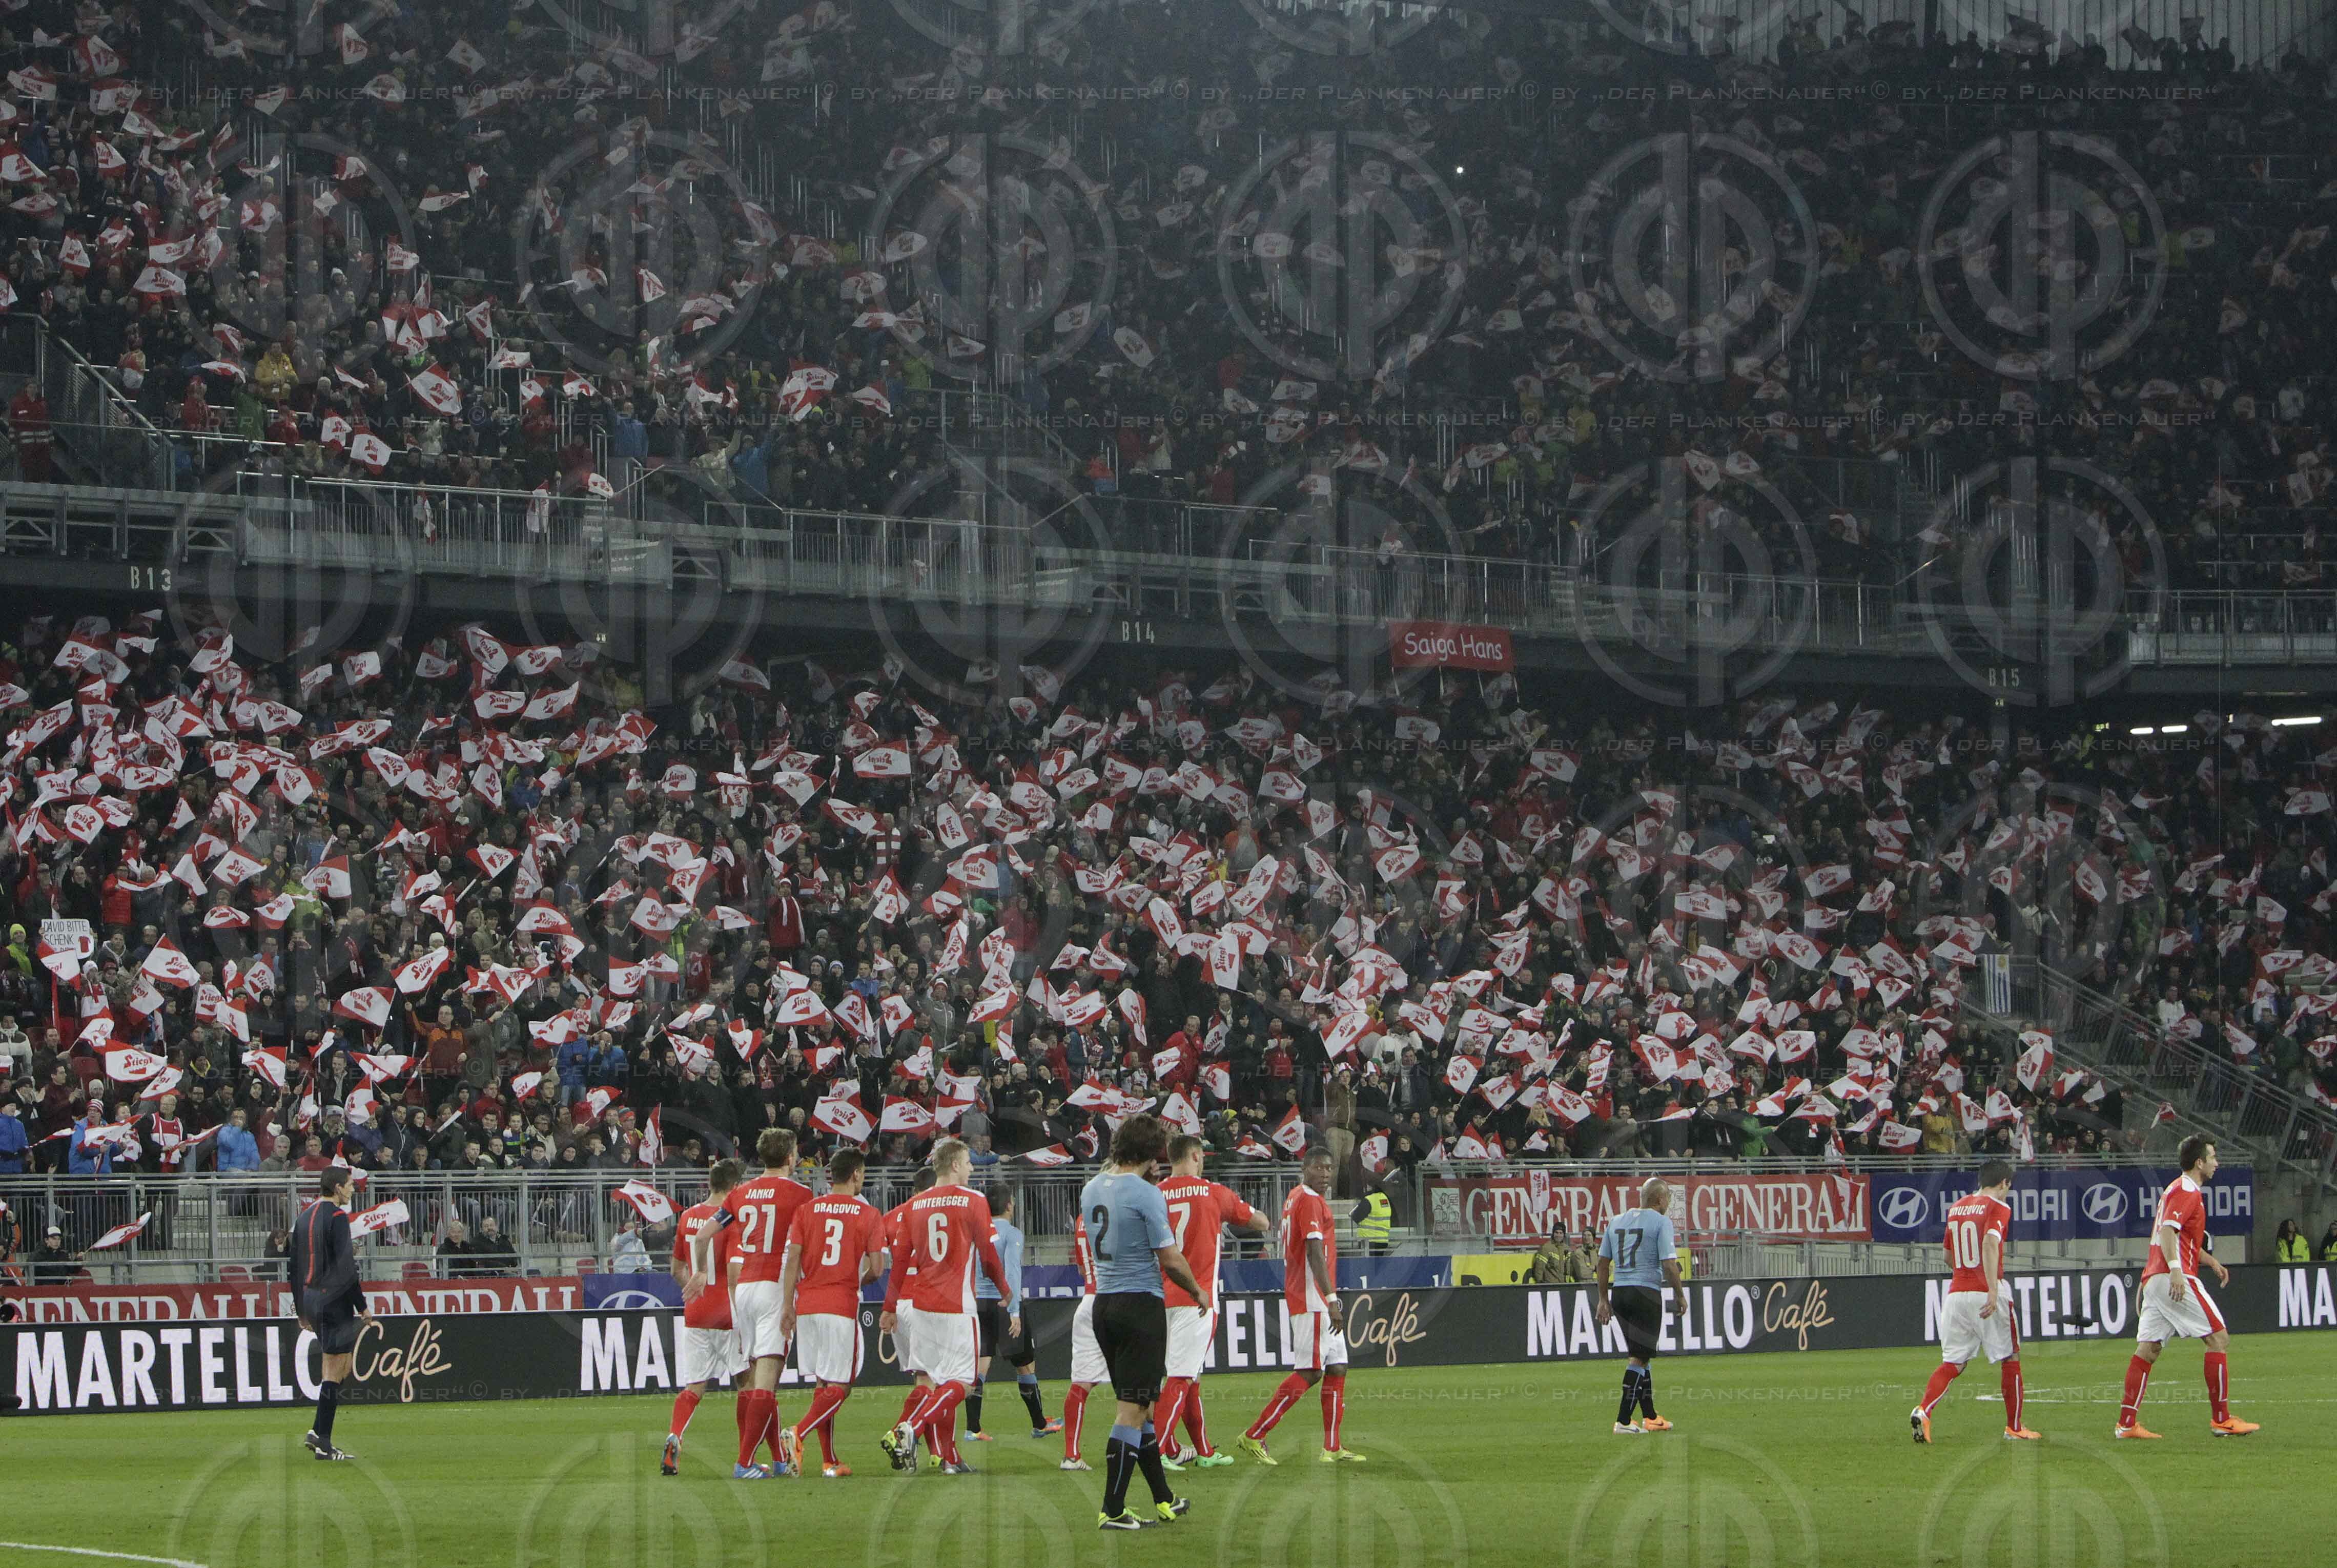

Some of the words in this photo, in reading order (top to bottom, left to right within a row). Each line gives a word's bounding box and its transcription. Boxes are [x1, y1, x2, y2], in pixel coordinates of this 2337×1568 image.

[1405, 632, 1458, 662] Saiga
[1461, 634, 1503, 661] Hans
[44, 921, 65, 933] DAVID
[67, 921, 87, 932] BITTE
[44, 934, 74, 945] SCHENK
[125, 1054, 153, 1068] Stiegl
[745, 1188, 774, 1199] JANKO
[814, 1203, 860, 1215] DRAGOVIC
[912, 1195, 969, 1210] HINTEREGGER
[1162, 1186, 1209, 1200] NAUTOVIC
[738, 1204, 776, 1253] 21
[821, 1219, 844, 1266] 3
[928, 1212, 948, 1262] 6
[1092, 1205, 1113, 1261] 2
[1169, 1202, 1190, 1252] 7
[1614, 1228, 1644, 1268] 17
[1948, 1221, 1980, 1269] 10
[1347, 1292, 1426, 1367] Café
[1527, 1284, 1753, 1356] MARELLO
[1764, 1280, 1835, 1350] Café
[352, 1319, 452, 1402] Café
